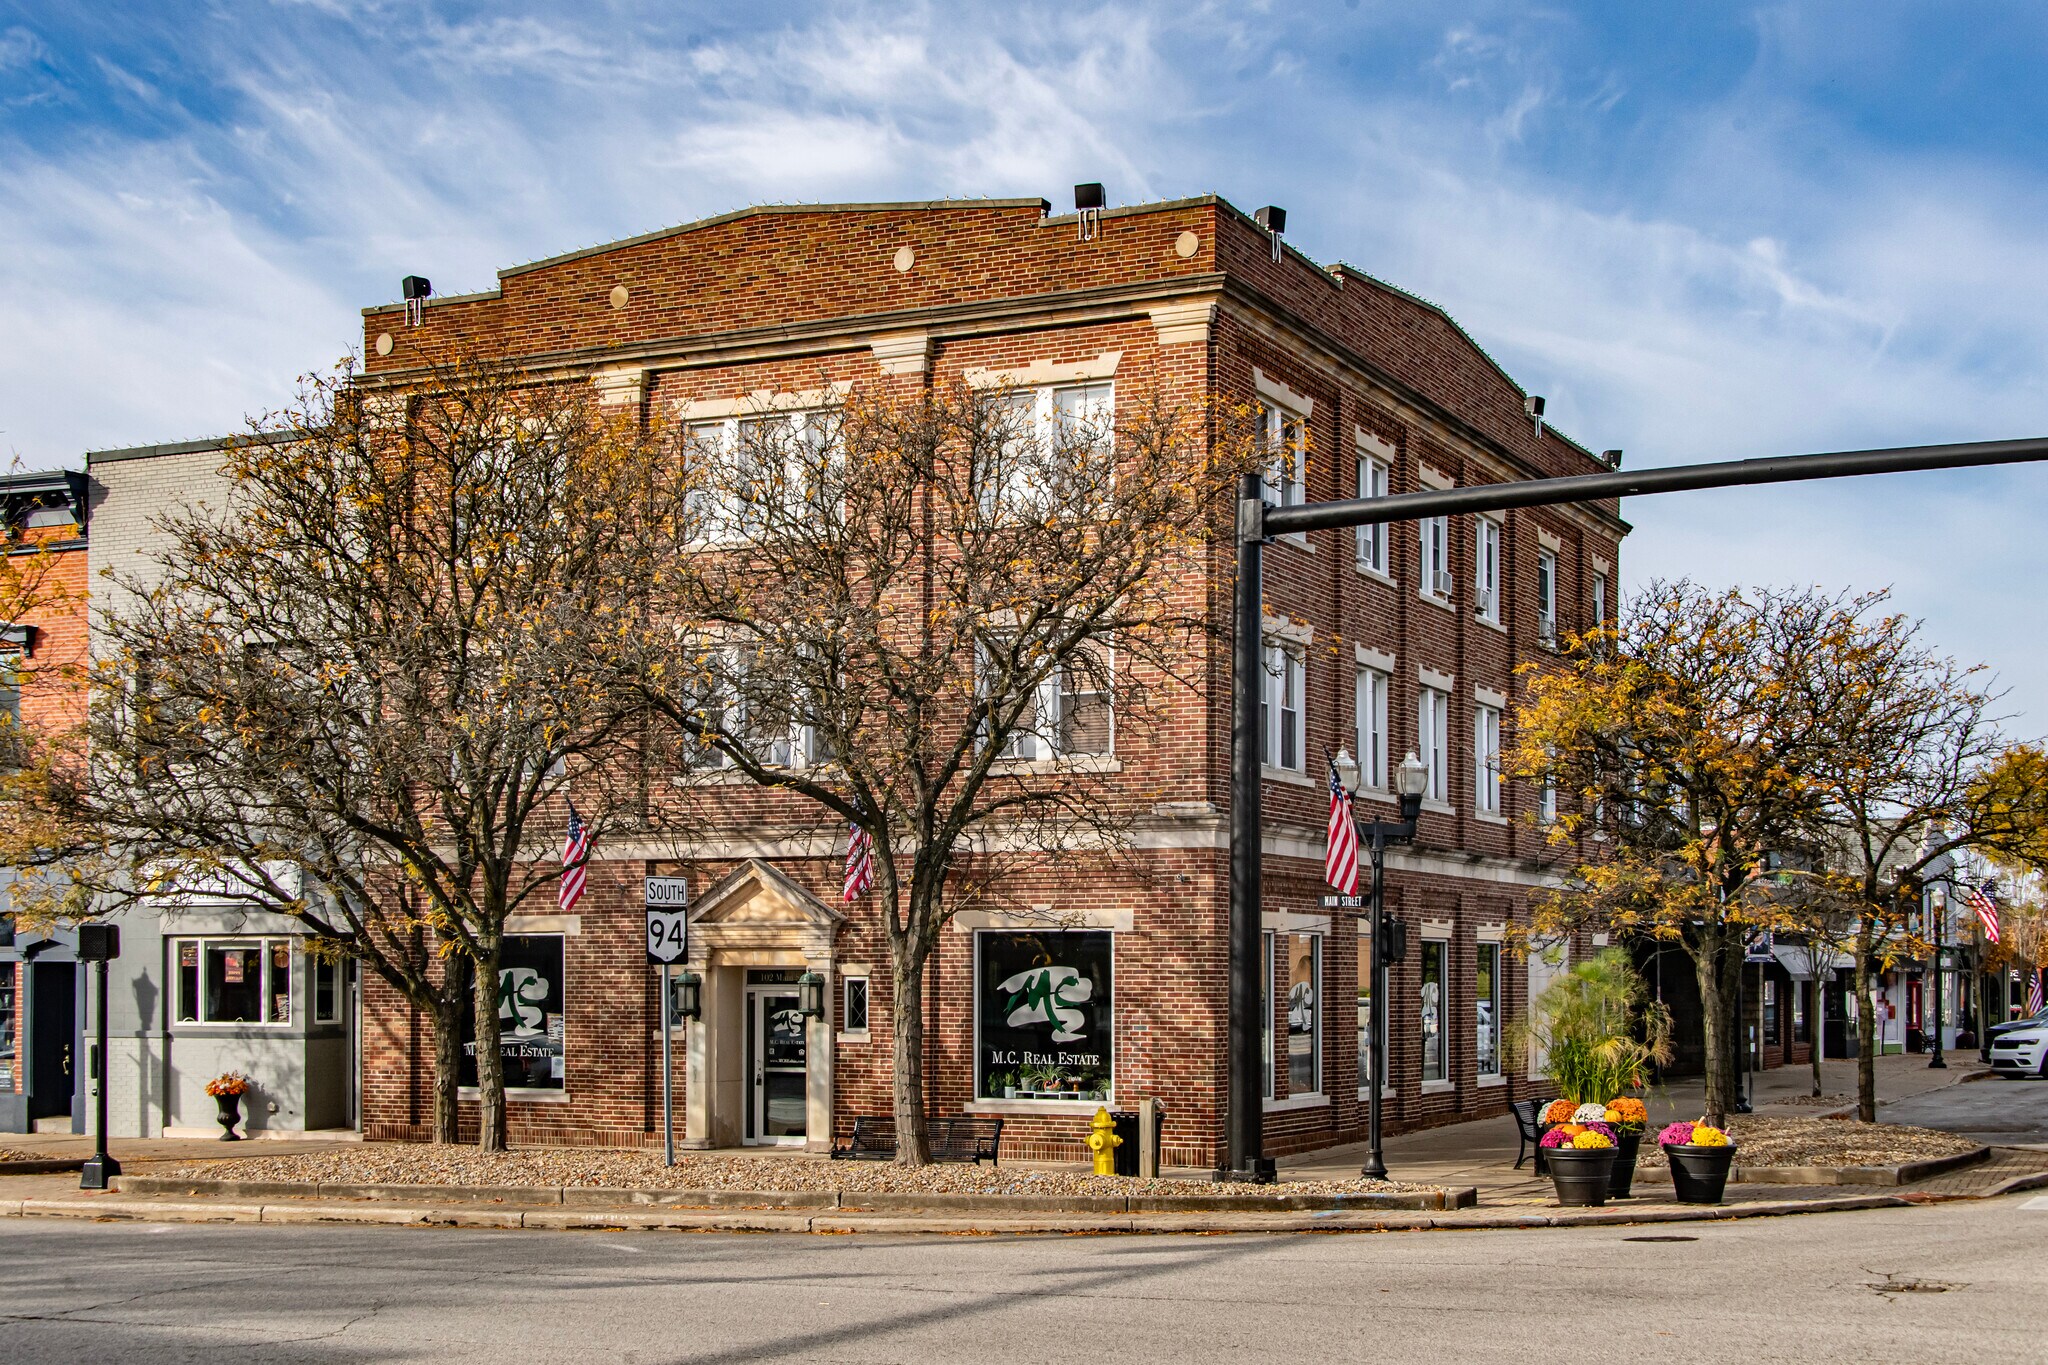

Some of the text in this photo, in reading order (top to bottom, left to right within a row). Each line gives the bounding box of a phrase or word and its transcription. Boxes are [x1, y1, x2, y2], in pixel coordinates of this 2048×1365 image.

[648, 881, 685, 901] SOUTH
[1324, 895, 1362, 907] MAIN STREET
[650, 918, 683, 950] 94
[761, 973, 774, 982] 102
[500, 1047, 517, 1057] EAL
[520, 1045, 555, 1057] ESTATE
[992, 1051, 1100, 1066] M.C. REAL ESTATE
